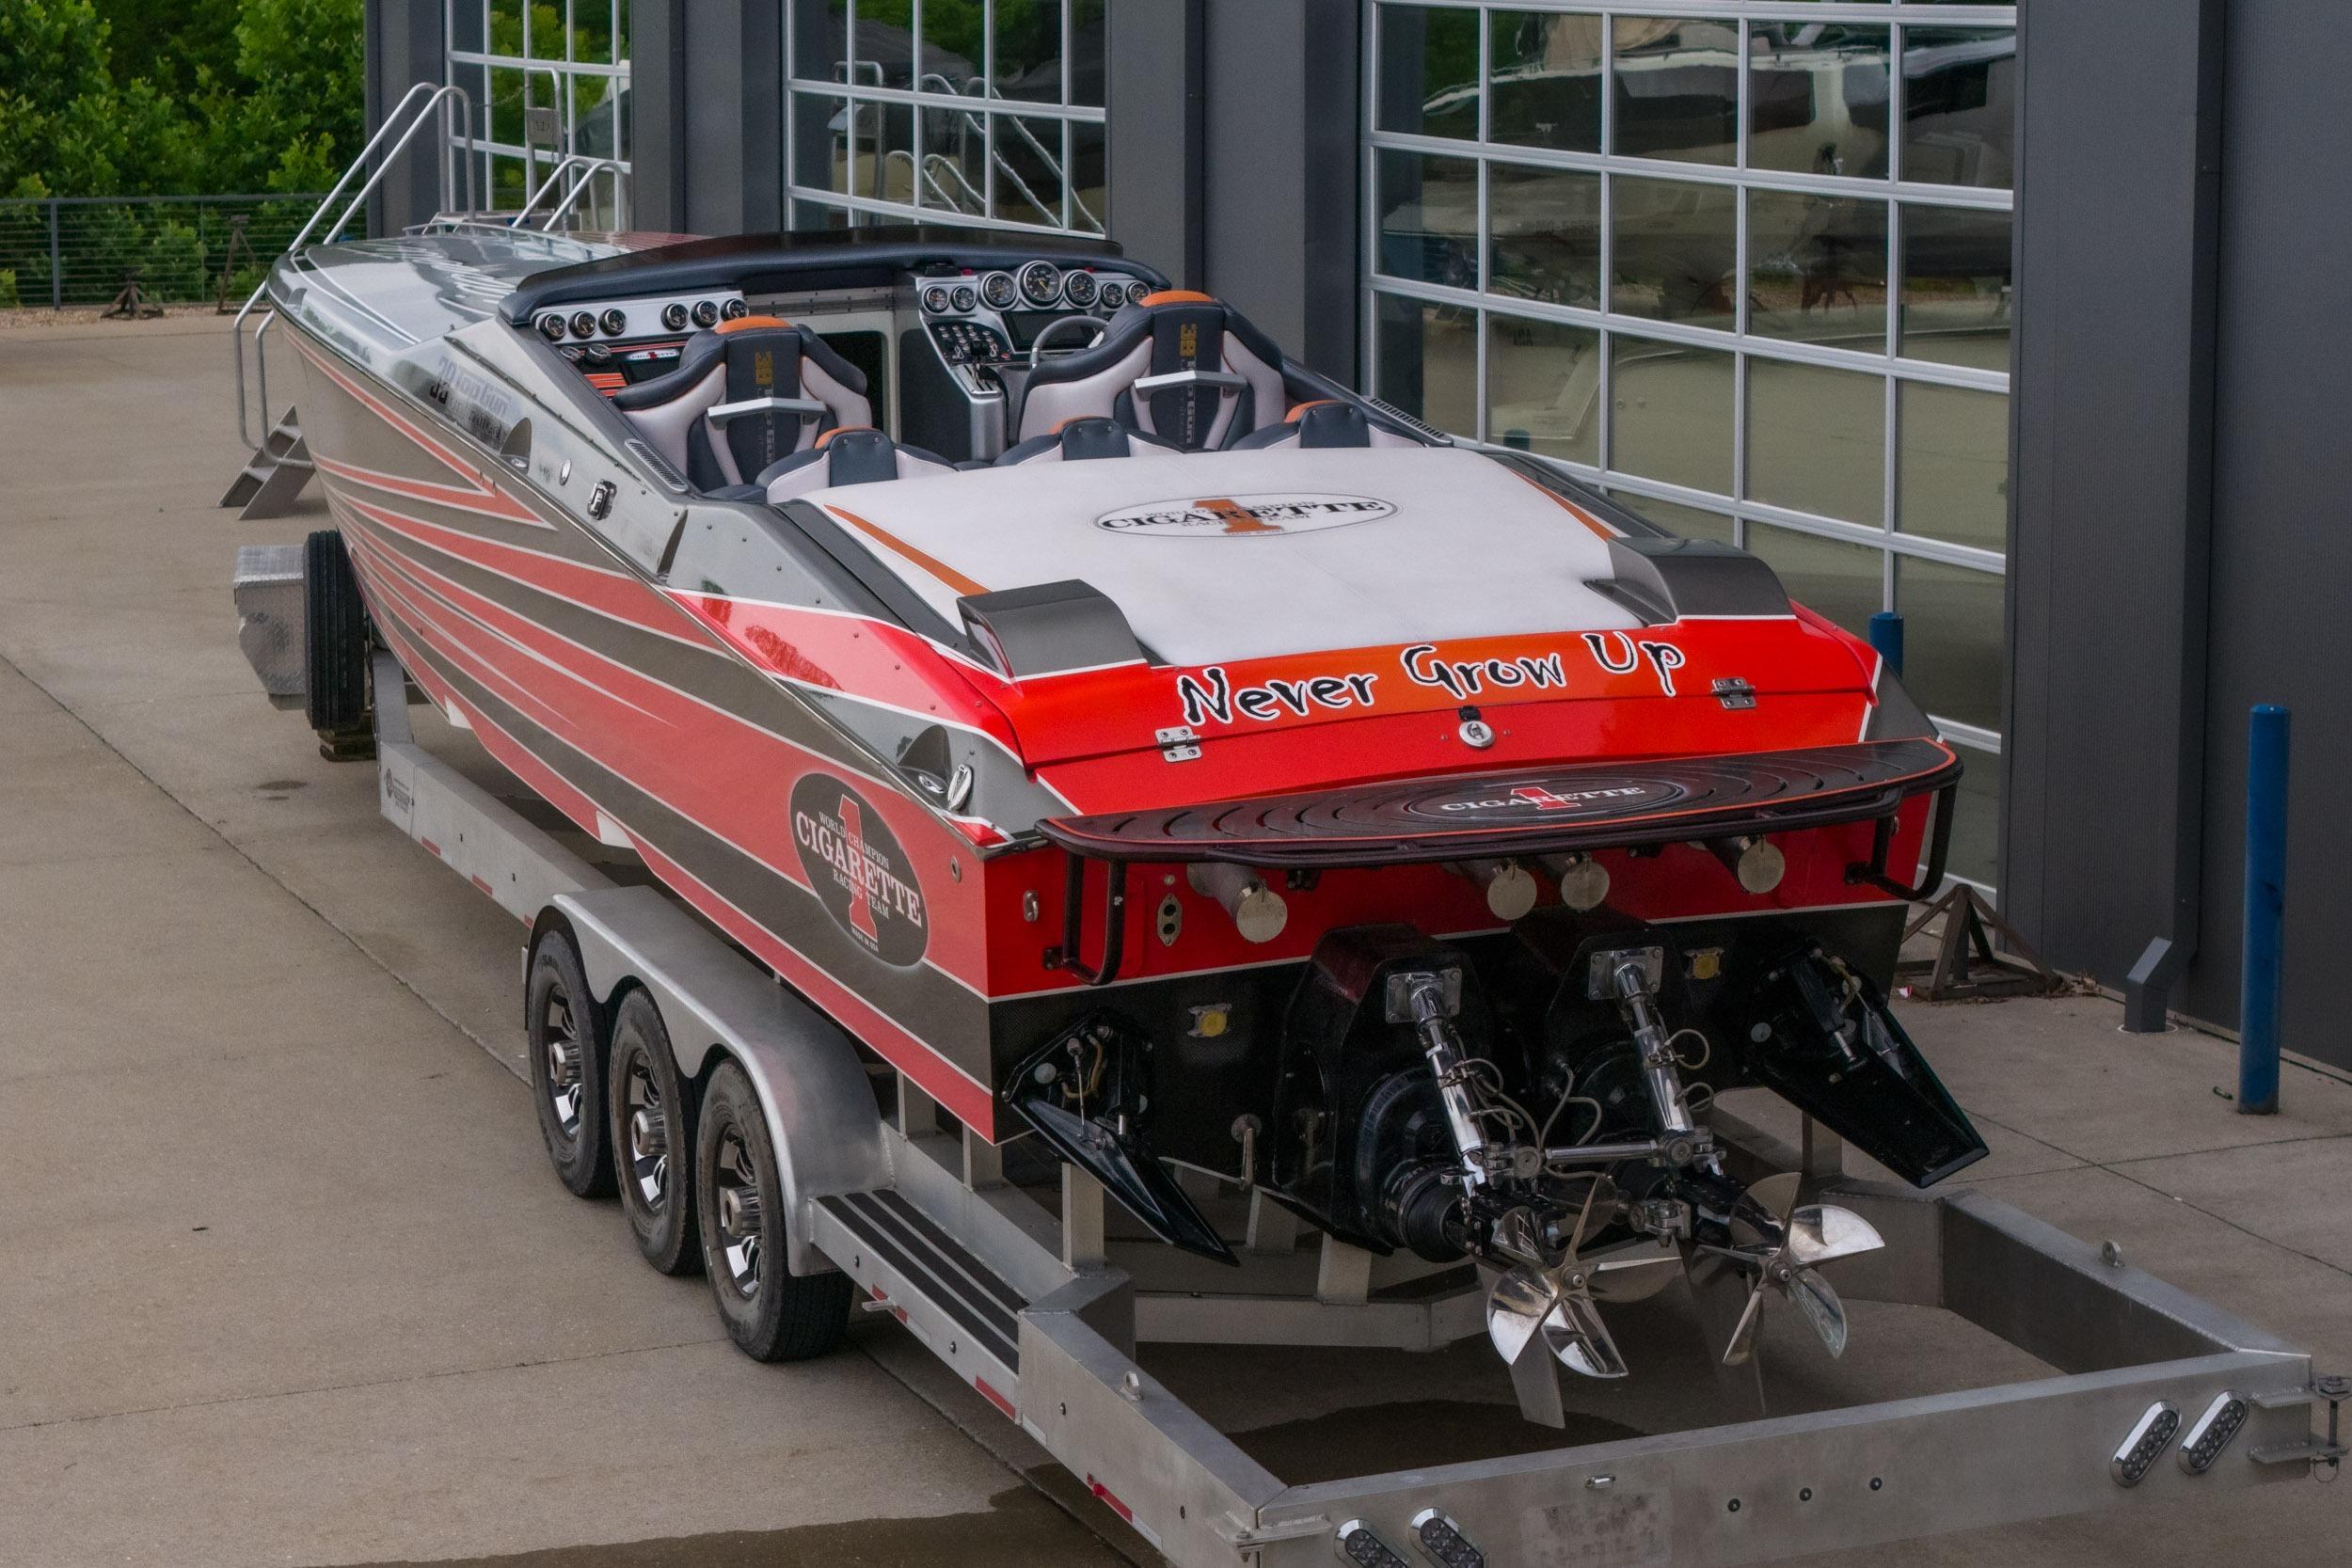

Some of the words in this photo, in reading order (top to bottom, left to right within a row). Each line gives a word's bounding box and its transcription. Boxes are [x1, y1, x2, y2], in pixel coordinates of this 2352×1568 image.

[1102, 500, 1386, 529] CIGARETTE
[1178, 667, 1378, 726] Never
[1401, 643, 1566, 699] Grow
[1581, 631, 1686, 696] Up
[1441, 786, 1646, 811] CIGARETTE
[818, 811, 846, 839] WORLD
[848, 832, 890, 870] CHAMPION
[796, 811, 922, 928] CIGARETTE
[833, 868, 863, 899] RACING
[868, 893, 890, 919] TEAM
